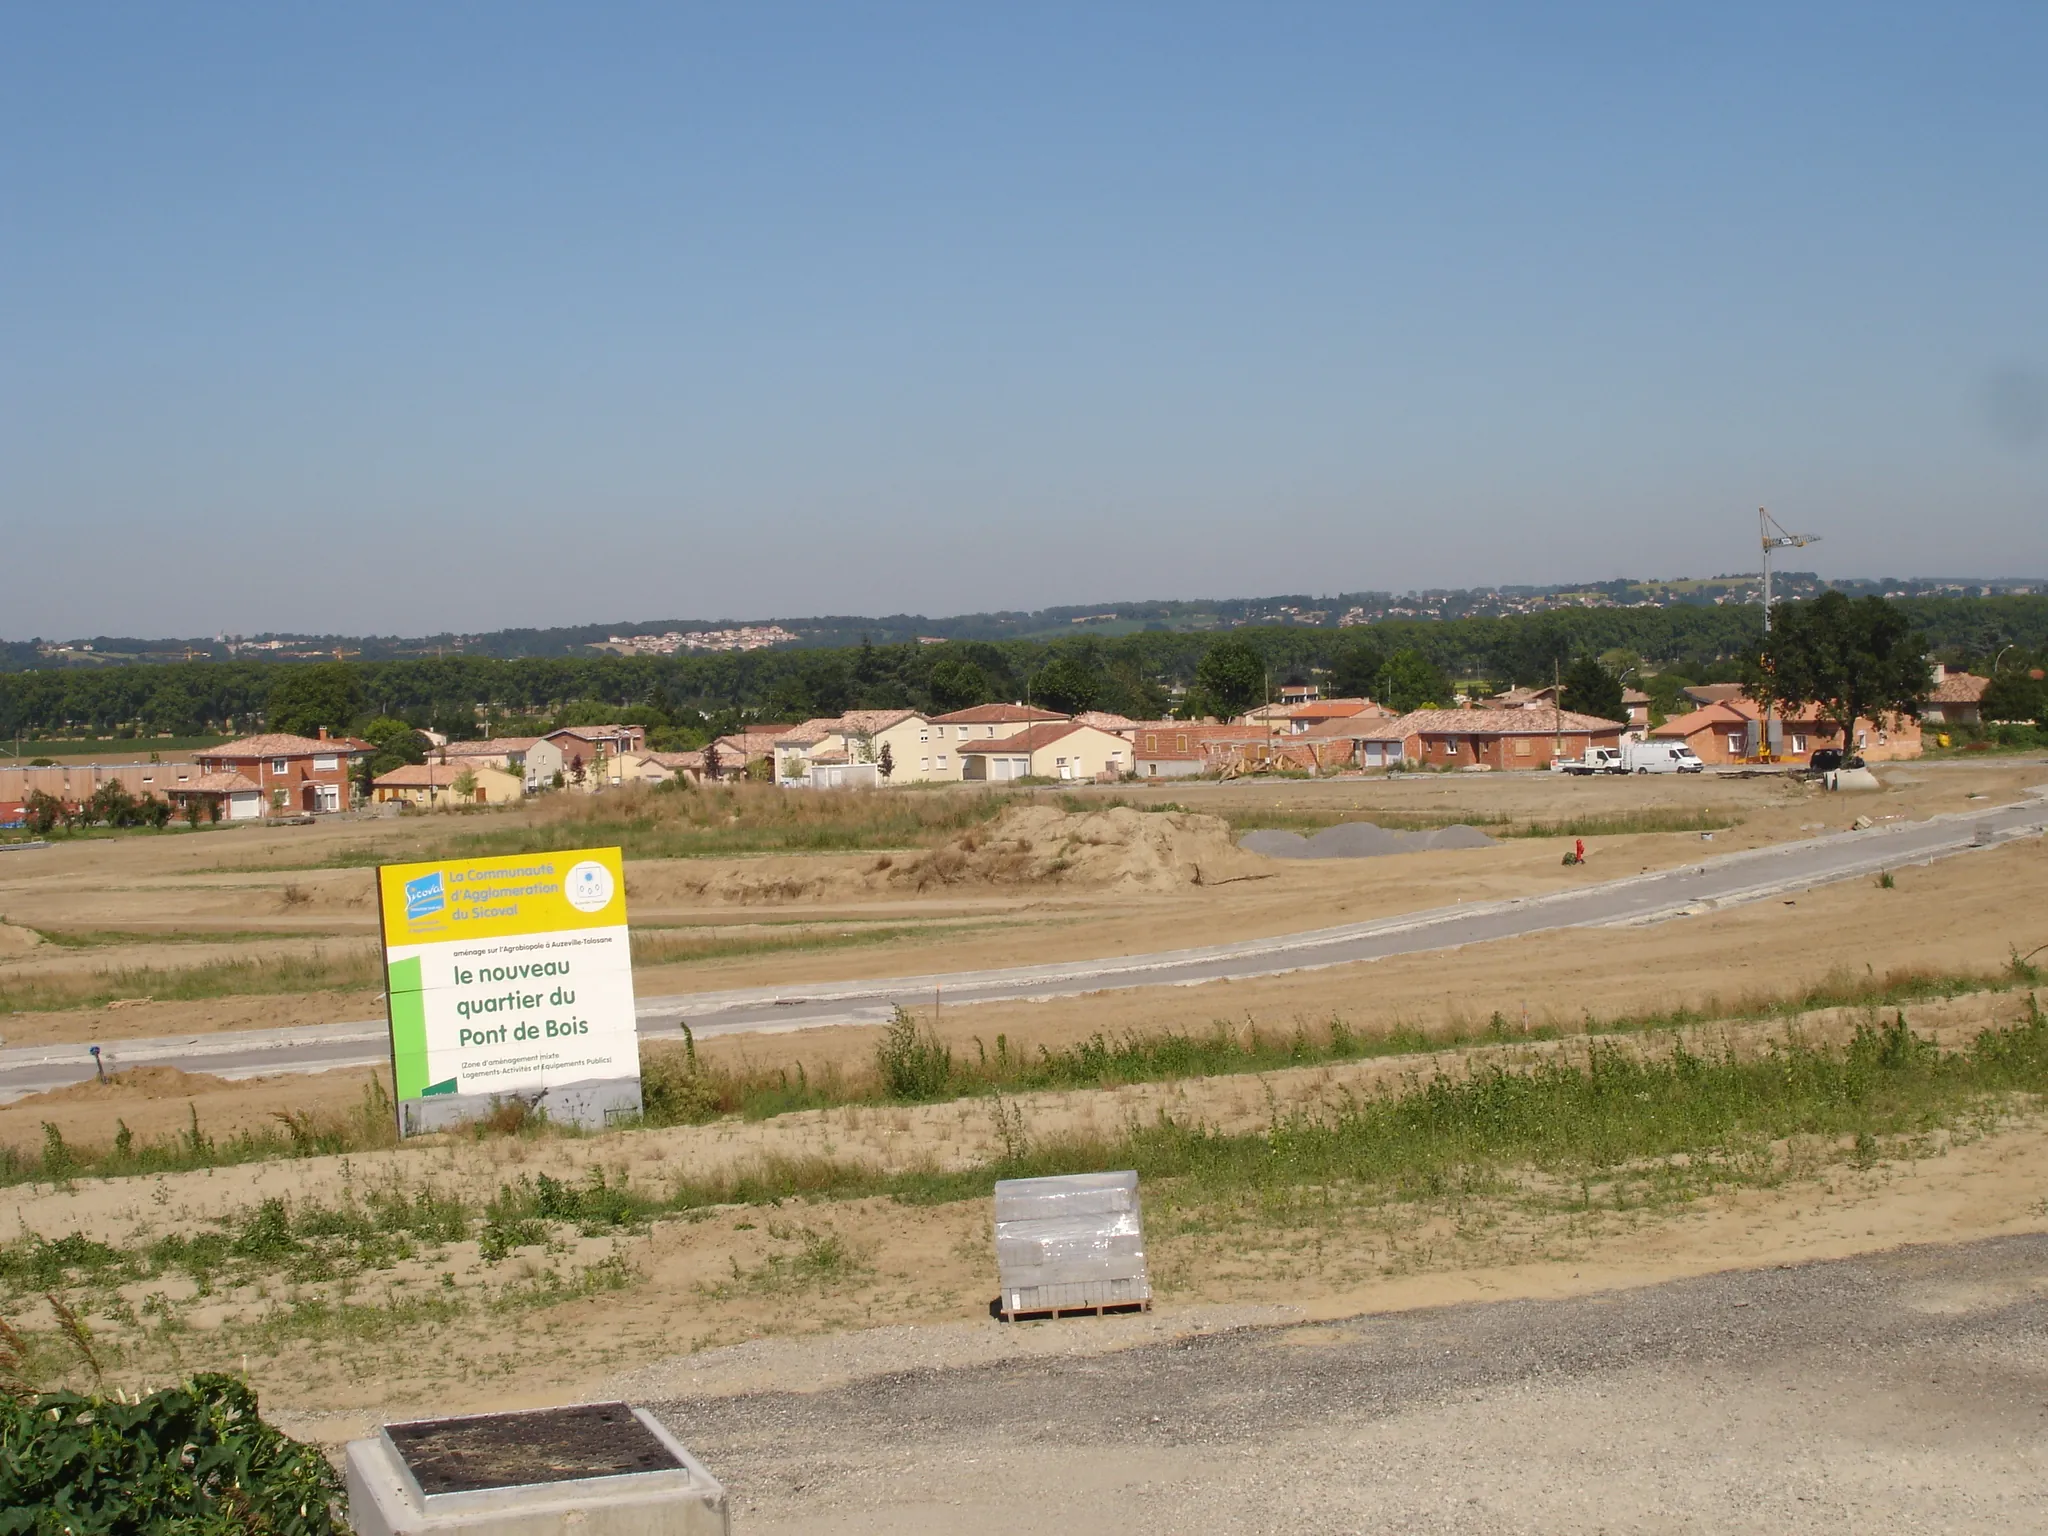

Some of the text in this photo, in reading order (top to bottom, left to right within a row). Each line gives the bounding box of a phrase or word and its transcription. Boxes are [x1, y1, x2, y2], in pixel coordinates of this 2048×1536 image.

[449, 863, 555, 883] La Communauté
[452, 908, 469, 921] du
[472, 904, 519, 919] Sicoval
[499, 943, 544, 954] l'Agrobiopole
[454, 960, 570, 985] le nouveau
[456, 986, 576, 1020] quartier du
[459, 1016, 589, 1047] Pont de Bois
[540, 1052, 560, 1060] mixte
